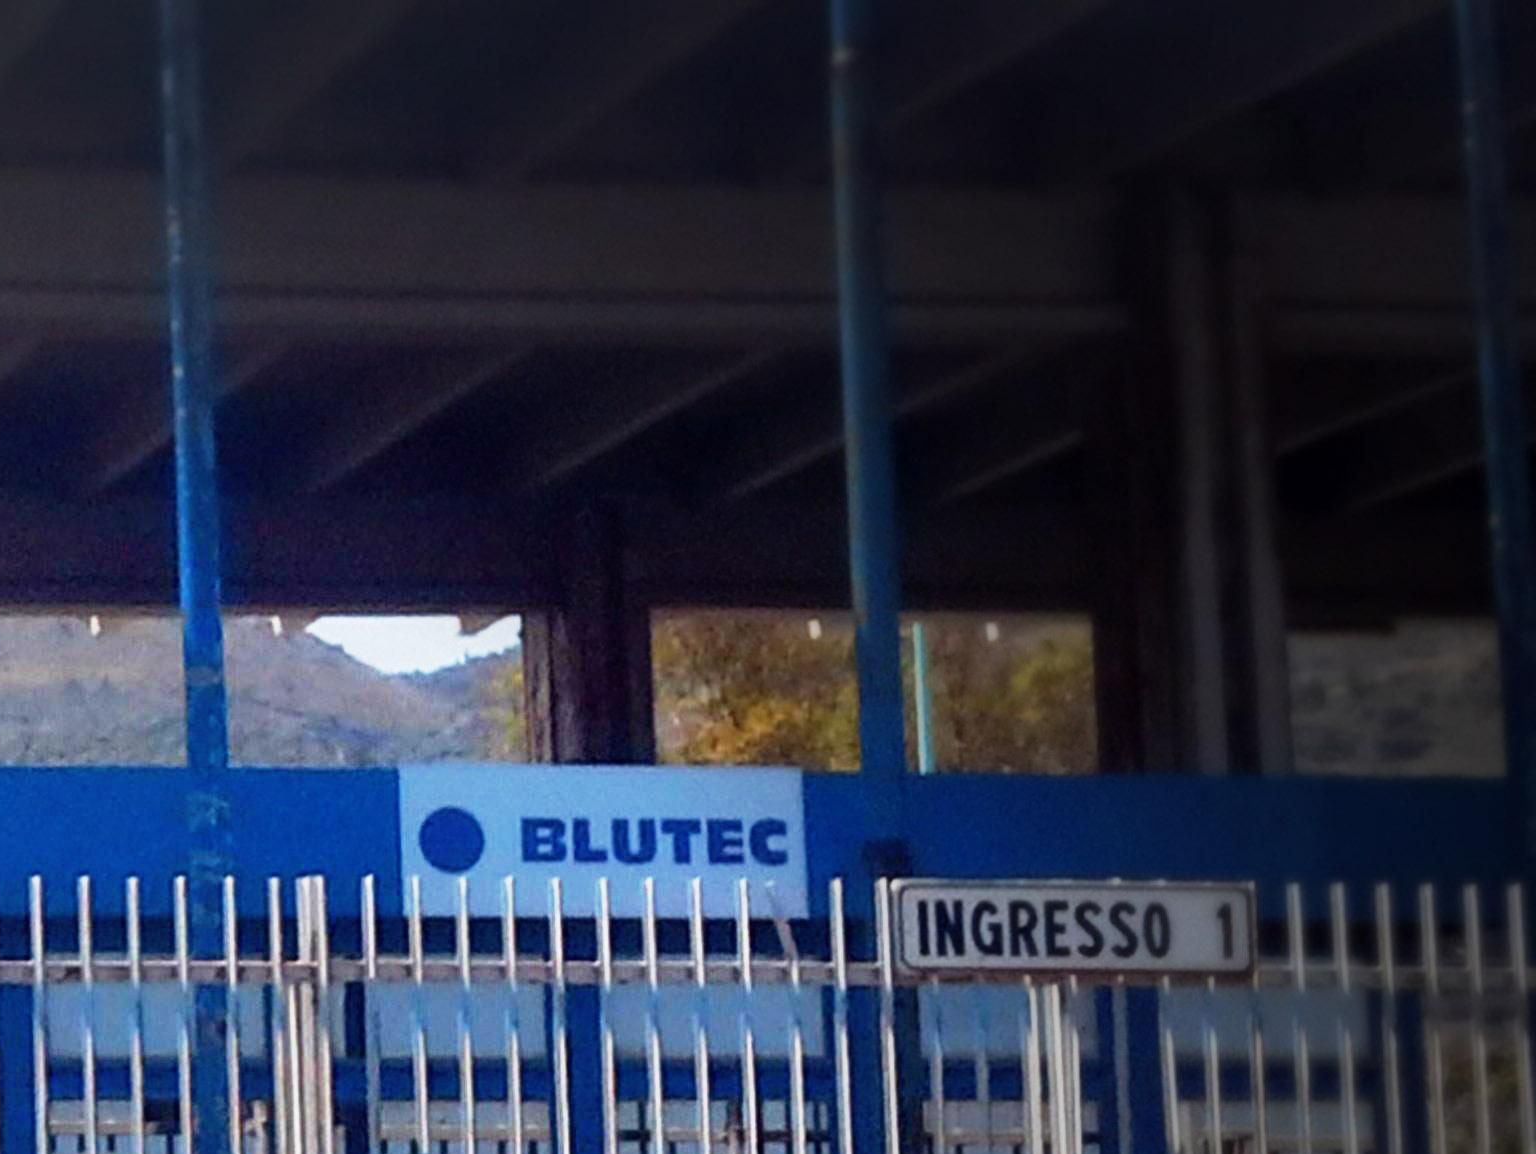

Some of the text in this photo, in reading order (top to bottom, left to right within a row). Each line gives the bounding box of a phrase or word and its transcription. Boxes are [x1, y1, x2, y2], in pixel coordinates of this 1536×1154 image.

[521, 817, 788, 866] BLUTEC
[917, 899, 1235, 960] INGRESSO 1
